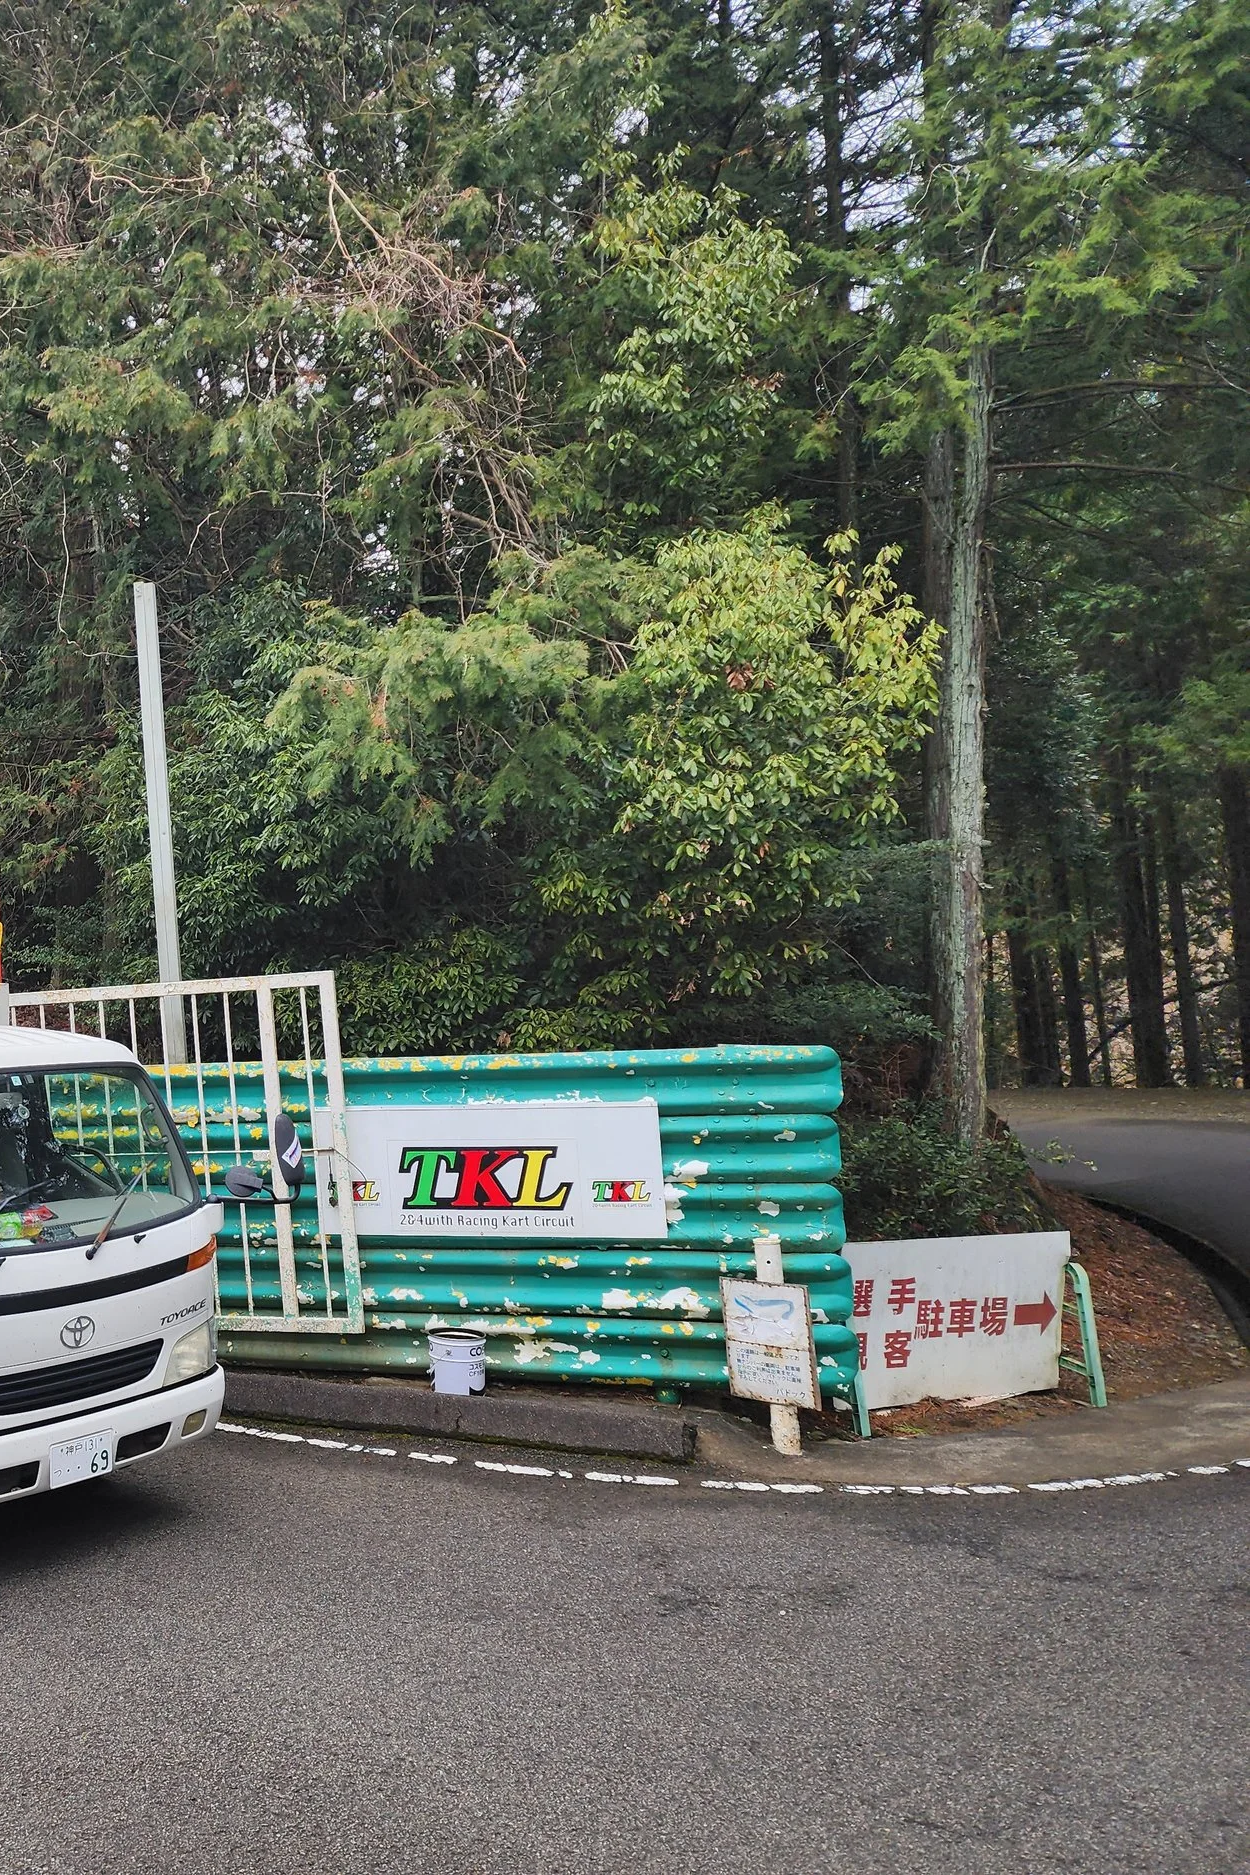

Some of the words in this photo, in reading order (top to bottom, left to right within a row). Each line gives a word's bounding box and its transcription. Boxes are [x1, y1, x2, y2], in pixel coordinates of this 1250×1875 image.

[399, 1146, 574, 1210] TKL
[592, 1180, 652, 1202] TKL
[400, 1214, 453, 1227] 2&4with
[457, 1215, 498, 1229] Racing
[502, 1215, 530, 1227] Kart
[534, 1215, 575, 1227] Circuit
[160, 1298, 207, 1326] TOYOACE
[914, 1297, 1008, 1340] 駐車場
[469, 1346, 484, 1357] CO
[90, 1449, 109, 1473] 69
